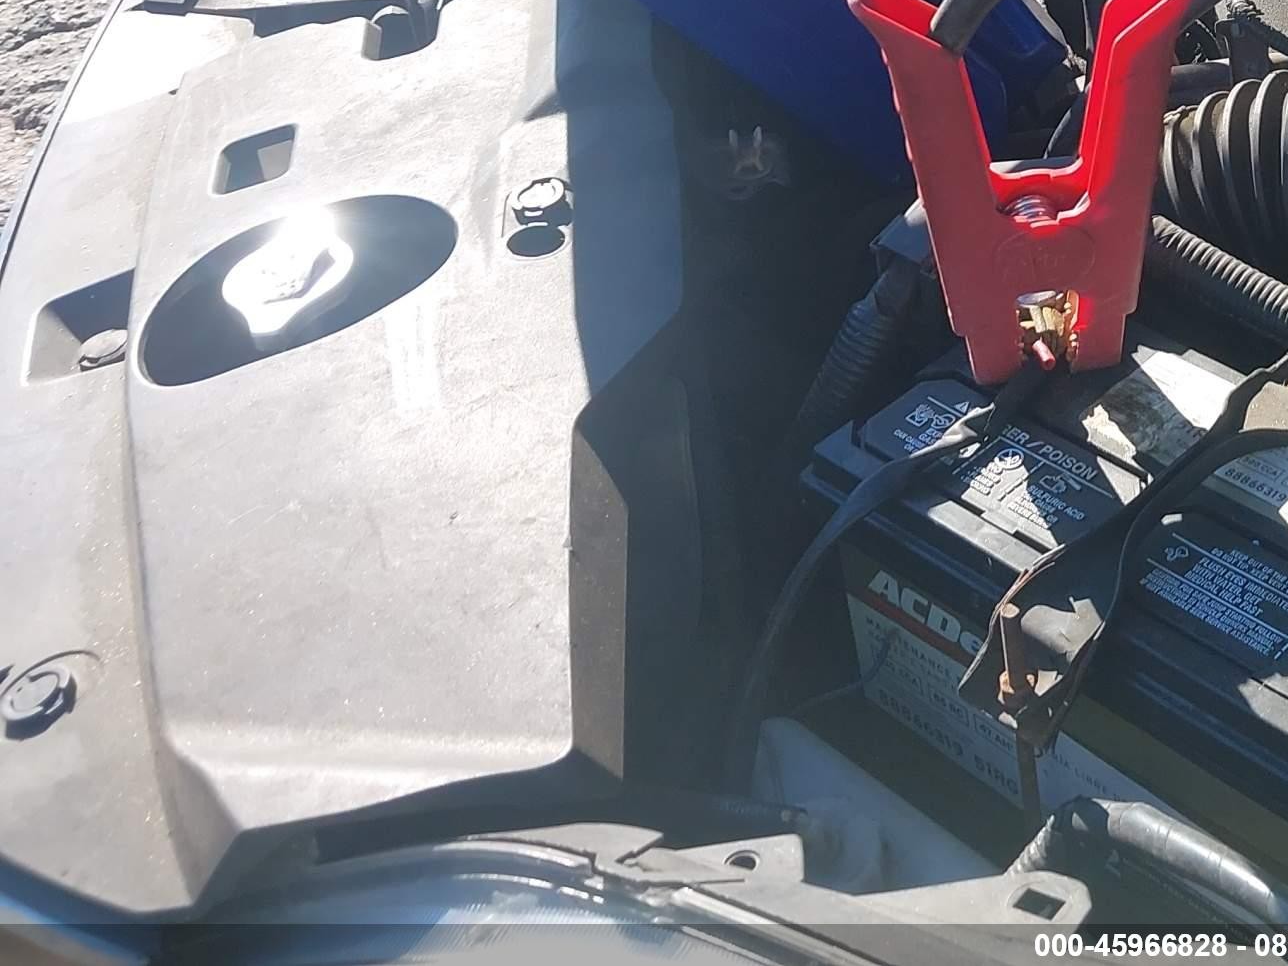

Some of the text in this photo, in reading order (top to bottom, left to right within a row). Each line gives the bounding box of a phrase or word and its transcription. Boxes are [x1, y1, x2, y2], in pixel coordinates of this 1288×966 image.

[1026, 483, 1085, 522] SULFURIC ACID
[1225, 468, 1287, 502] 88866319
[1183, 570, 1222, 594] MEDICAL
[1217, 589, 1242, 605] HELP
[1190, 563, 1216, 580] WITH
[1241, 591, 1263, 605] GET
[1197, 556, 1228, 575] FLUSH
[1223, 570, 1248, 586] EYES
